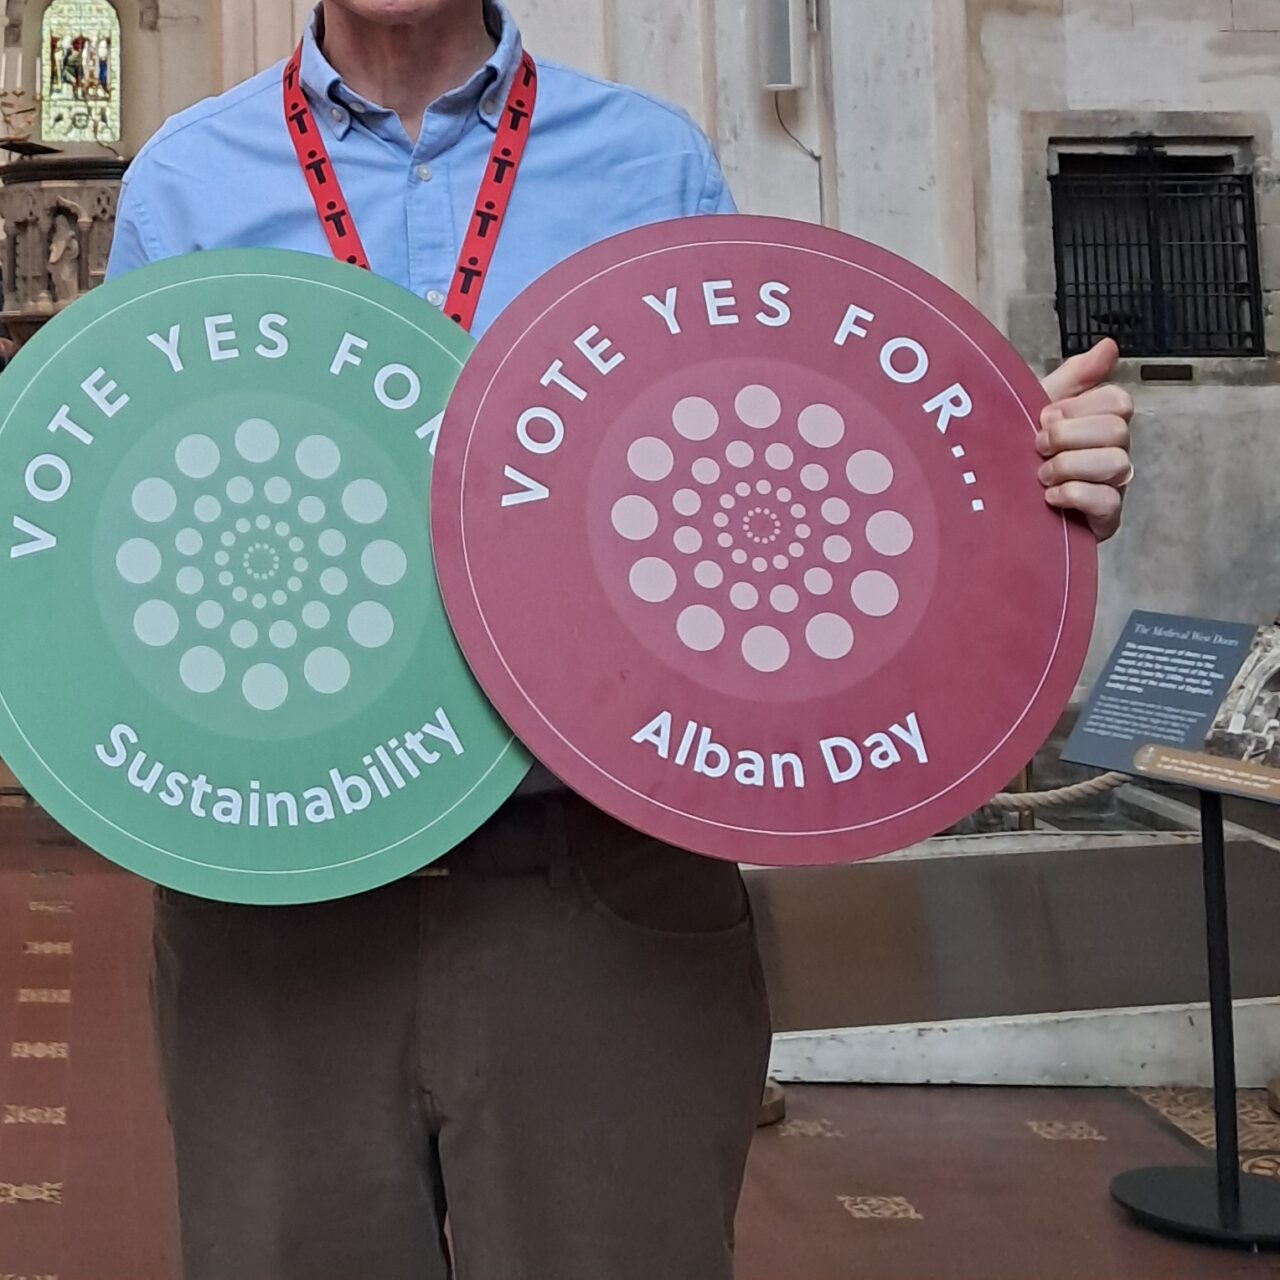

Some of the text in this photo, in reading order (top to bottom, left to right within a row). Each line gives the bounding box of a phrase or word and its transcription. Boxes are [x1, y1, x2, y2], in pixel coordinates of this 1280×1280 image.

[11, 367, 129, 558] VOTE
[147, 313, 289, 372] YES
[500, 279, 984, 511] VOTE YES FOR...
[95, 707, 464, 827] Sustainability
[632, 710, 928, 788] Alban Day
